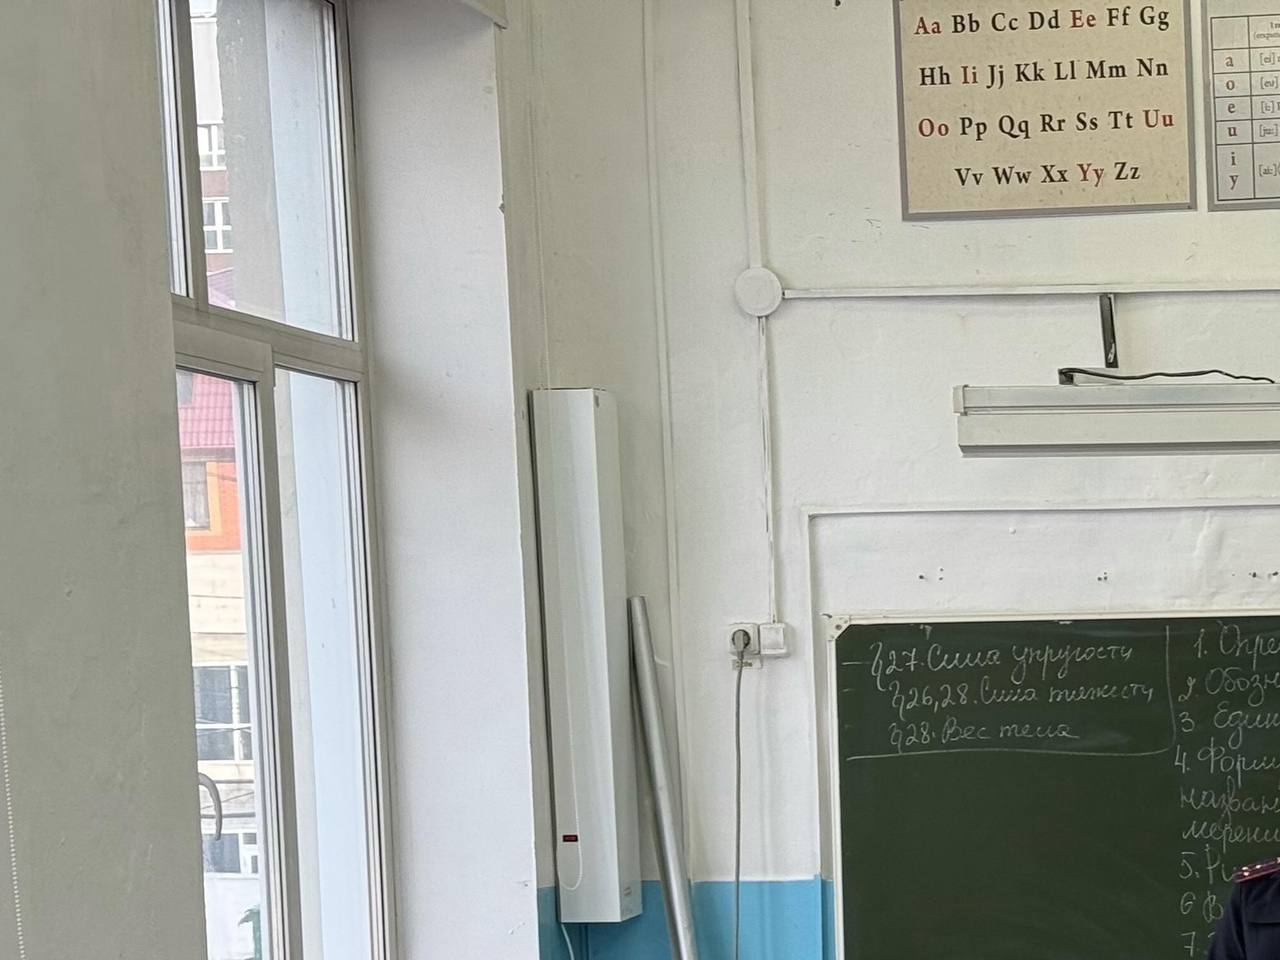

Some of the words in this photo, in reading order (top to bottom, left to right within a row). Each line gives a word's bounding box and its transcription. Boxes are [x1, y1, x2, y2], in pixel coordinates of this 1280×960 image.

[914, 17, 942, 35] Aa
[951, 14, 980, 33] Bb
[991, 12, 1018, 32] Cc
[1028, 11, 1060, 30] Dd
[1070, 9, 1097, 28] Ee
[1106, 6, 1131, 26] Ff
[1139, 6, 1169, 31] Gg
[1225, 57, 1234, 67] a
[919, 66, 952, 86] Hh
[961, 65, 979, 84] Ii
[986, 64, 1005, 89] Jj
[1015, 61, 1045, 82] Kk
[1054, 60, 1076, 81] Ll
[1086, 60, 1127, 80] Mm
[1136, 58, 1169, 77] Nn
[1226, 80, 1235, 90] o
[1228, 103, 1236, 113] e
[918, 118, 949, 137] Oo
[959, 117, 987, 141] Pp
[999, 115, 1031, 140] Qq
[1040, 113, 1066, 133] Rr
[1076, 111, 1098, 131] Ss
[1108, 110, 1134, 130] Tt
[1143, 109, 1175, 128] Uu
[1228, 126, 1237, 137] u
[1231, 152, 1236, 166] i
[955, 167, 984, 186] Vv
[992, 166, 1032, 185] Ww
[1040, 164, 1069, 183] Xx
[1077, 162, 1105, 187] Yy
[1114, 161, 1141, 181] Zz
[1229, 175, 1239, 190] y
[941, 716, 992, 743] Вес
